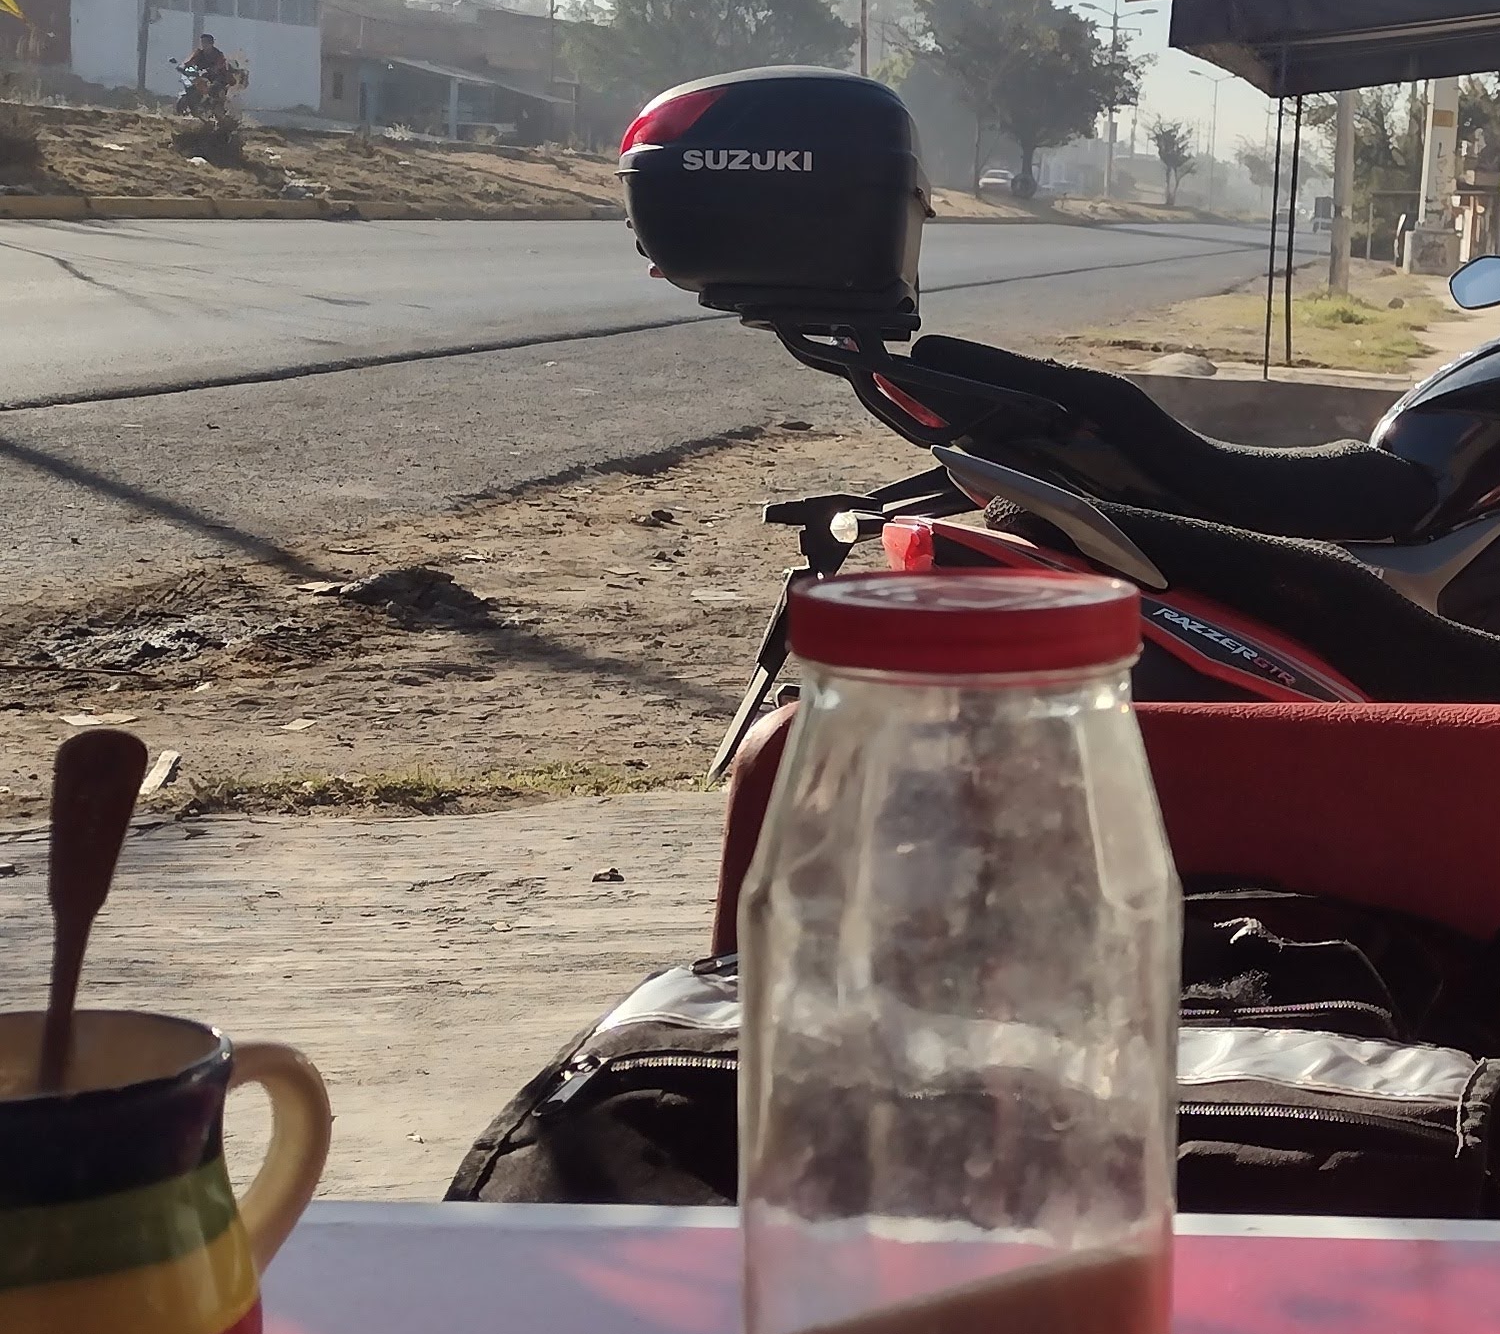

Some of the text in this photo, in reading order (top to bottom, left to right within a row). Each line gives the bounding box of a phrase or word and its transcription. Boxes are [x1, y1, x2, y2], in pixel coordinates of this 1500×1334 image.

[682, 149, 813, 172] SUZUKI
[1152, 607, 1296, 686] RAZZER GTR
